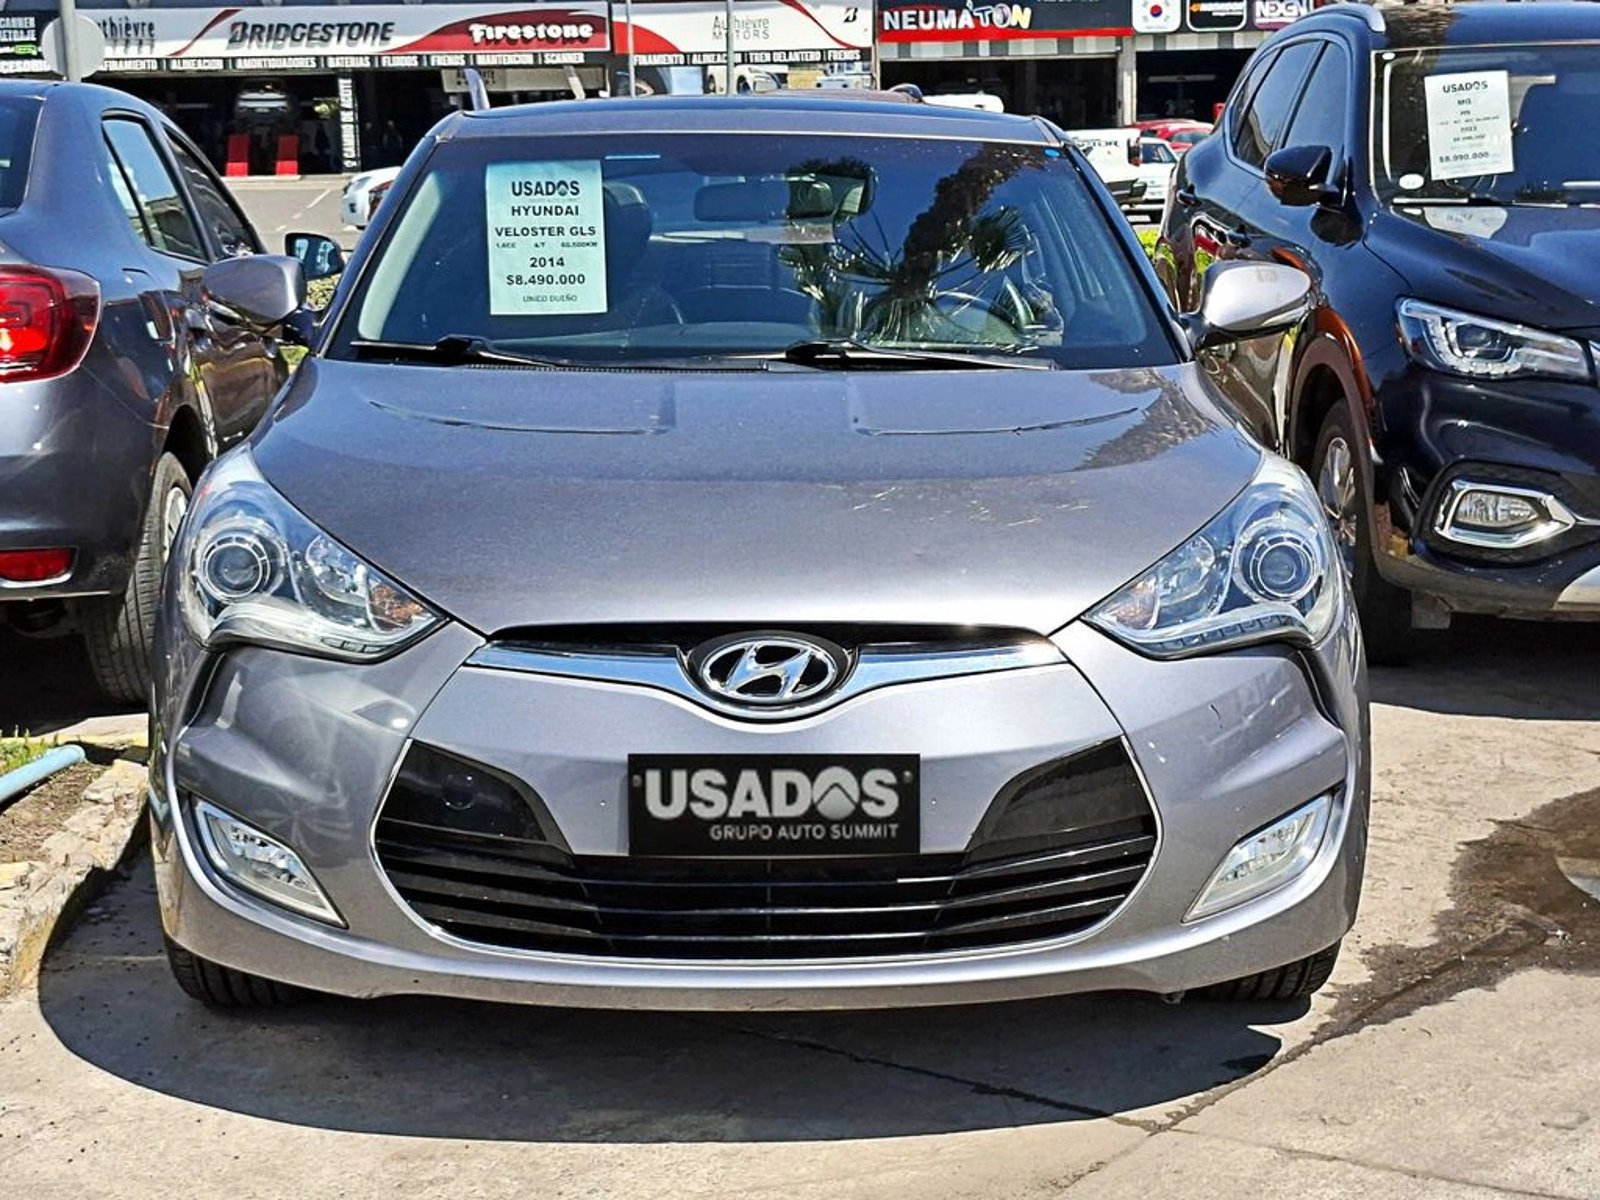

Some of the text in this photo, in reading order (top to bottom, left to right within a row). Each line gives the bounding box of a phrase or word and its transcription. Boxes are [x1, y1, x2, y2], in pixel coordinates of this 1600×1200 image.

[98, 16, 156, 38] thièvre
[229, 21, 395, 44] BRIDGESTONE
[469, 23, 594, 44] Firestone
[712, 30, 770, 41] MTORS
[633, 54, 684, 66] FINAMIENTO
[1442, 80, 1489, 94] USADOS
[511, 180, 580, 197] USADOS
[511, 205, 579, 217] HYUNDAI
[495, 226, 596, 237] VELOSTER GLS
[529, 257, 565, 268] 2014
[506, 274, 586, 286] $8.490.000
[644, 765, 900, 821] USADOS
[709, 823, 899, 841] GRUPO AUTO SUMMIT
